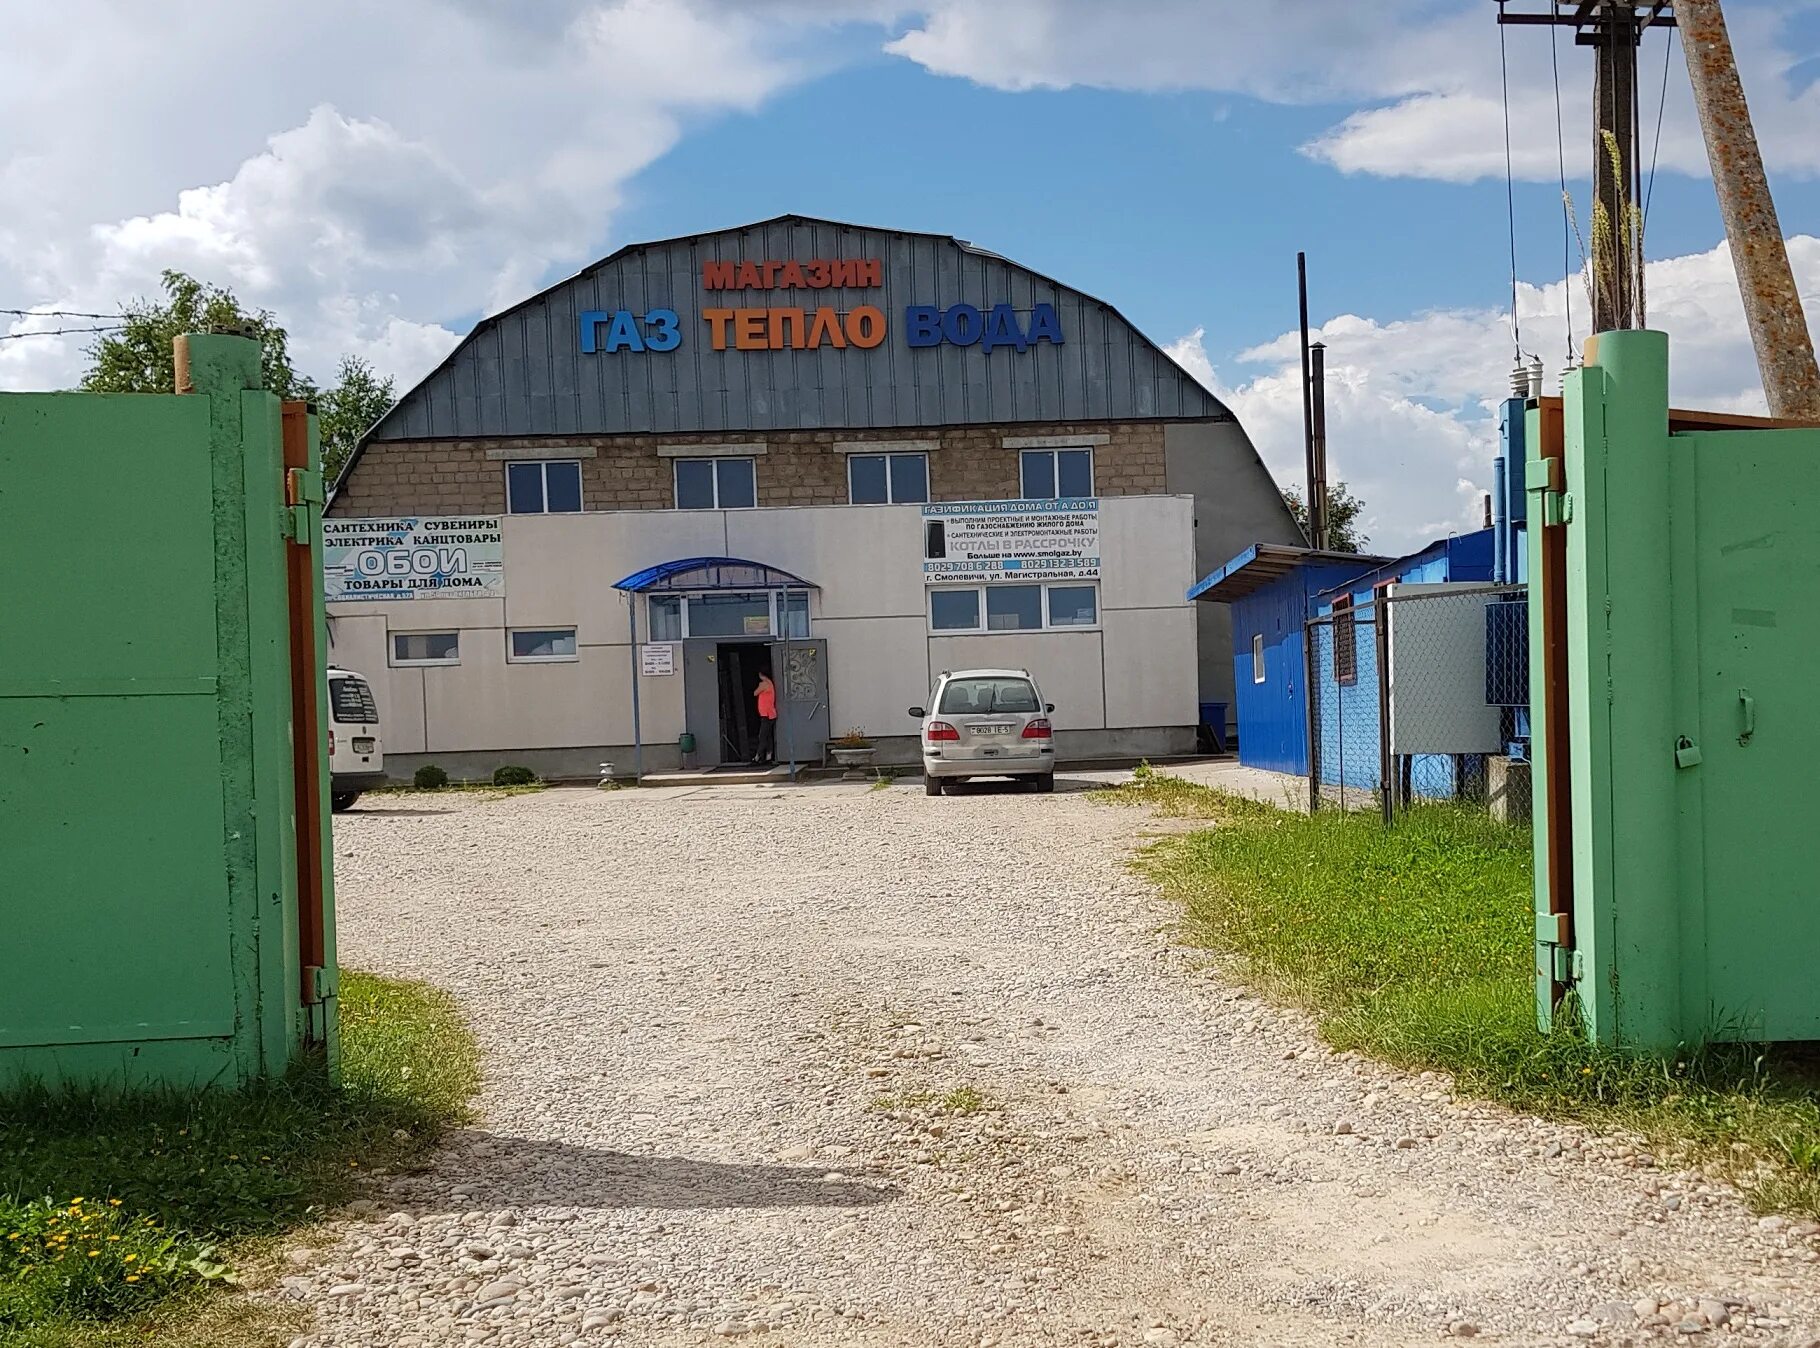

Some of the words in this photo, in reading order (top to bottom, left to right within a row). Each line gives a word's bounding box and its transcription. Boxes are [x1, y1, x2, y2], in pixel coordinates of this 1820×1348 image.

[703, 259, 882, 291] МАГАЗИН
[579, 309, 682, 353] ГАЗ
[703, 306, 887, 351] ТЕПЛО
[906, 303, 1065, 354] ВОДА
[924, 504, 1008, 514] ГАЗИФИКАЦИЯ
[1010, 503, 1043, 511] ДОМА
[1045, 502, 1059, 510] ОТ
[1061, 502, 1069, 510] А
[1070, 501, 1086, 510] ДО
[1088, 501, 1096, 509] Я
[950, 517, 986, 525] ВЫПОЛНИМ
[987, 515, 1024, 524] ПРОЕКТНЫЕ
[1031, 514, 1071, 522] МОНТАЖНЫЕ
[1071, 513, 1098, 521] РАБОТЫ
[323, 522, 414, 533] САНТЕХНИКА
[424, 520, 498, 530] СУВЕНИРЫ
[976, 521, 1035, 530] ГАЗОСНАБЖЕНИЮ
[1065, 520, 1084, 528] ДОМА
[951, 531, 1004, 539] САНТЕХНИЧЕСКИЕ
[1010, 528, 1073, 537] ЭЛЕКТРОМОНТАЖНЫЕ
[325, 536, 404, 547] ЭЛЕКТРИКА
[413, 534, 501, 545] КАНЦТОВАРЫ
[950, 540, 1000, 551] КОТЛЫ
[1002, 540, 1012, 550] В
[1014, 537, 1095, 550] РАССРОЧКУ
[967, 552, 1000, 560] Больше
[358, 548, 468, 577] ОБОИ
[989, 573, 1003, 581] ул.
[344, 579, 403, 590] ТОВАРЫ
[407, 578, 438, 590] ДЛЯ
[442, 577, 483, 588] ДОМА
